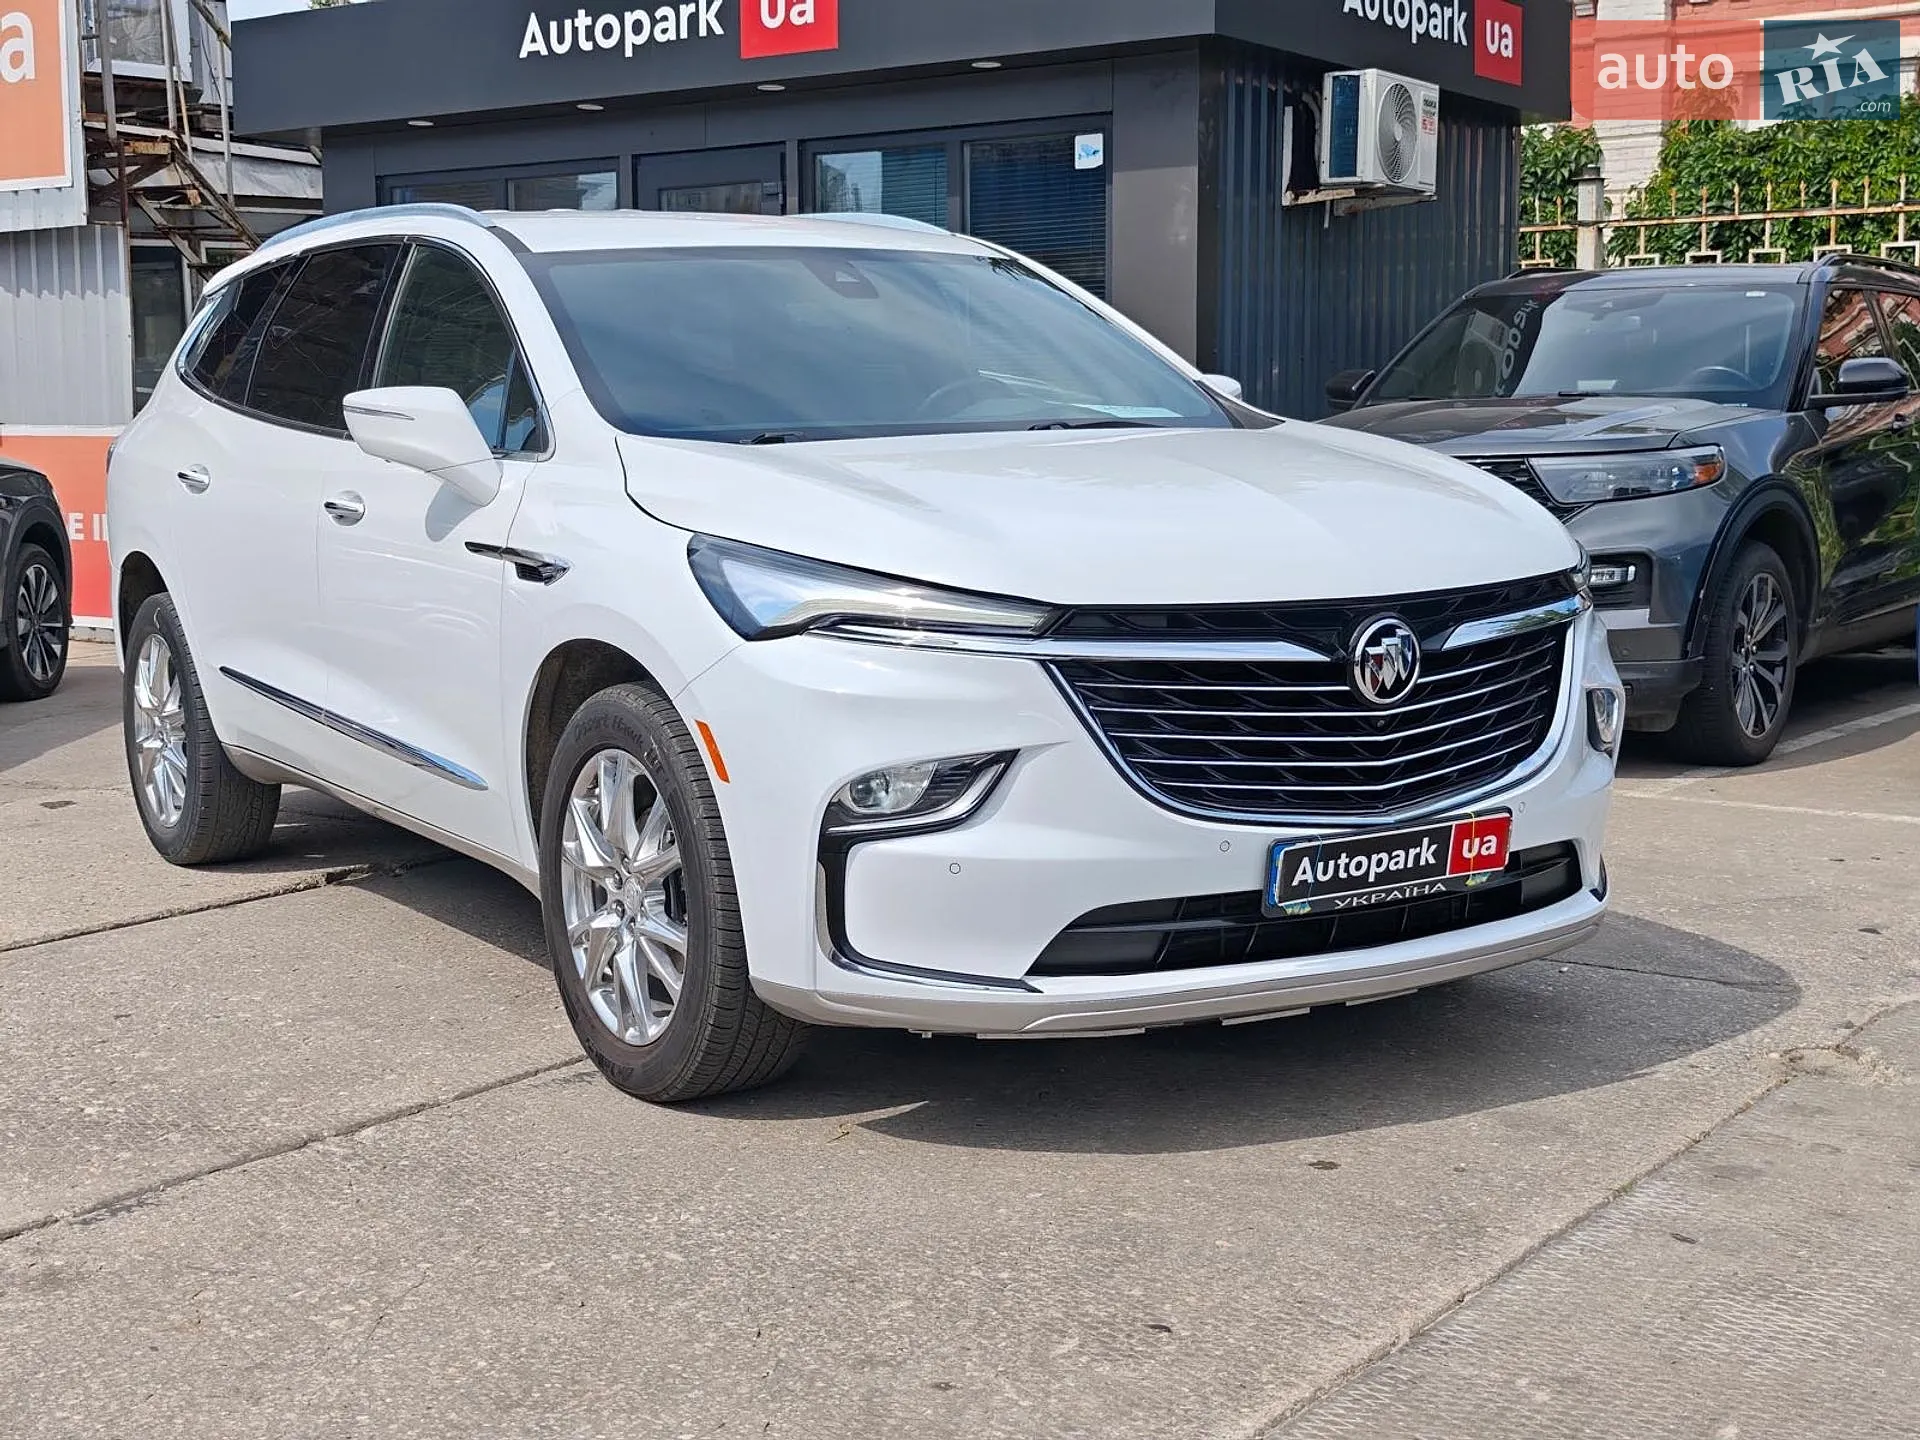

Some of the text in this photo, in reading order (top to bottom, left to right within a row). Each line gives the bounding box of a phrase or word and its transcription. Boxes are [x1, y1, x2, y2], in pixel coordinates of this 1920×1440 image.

[519, 0, 724, 58] Autopark
[1485, 19, 1513, 58] ua
[1291, 834, 1498, 886] Autopark ua
[1335, 881, 1447, 909] УКРАЇНА
